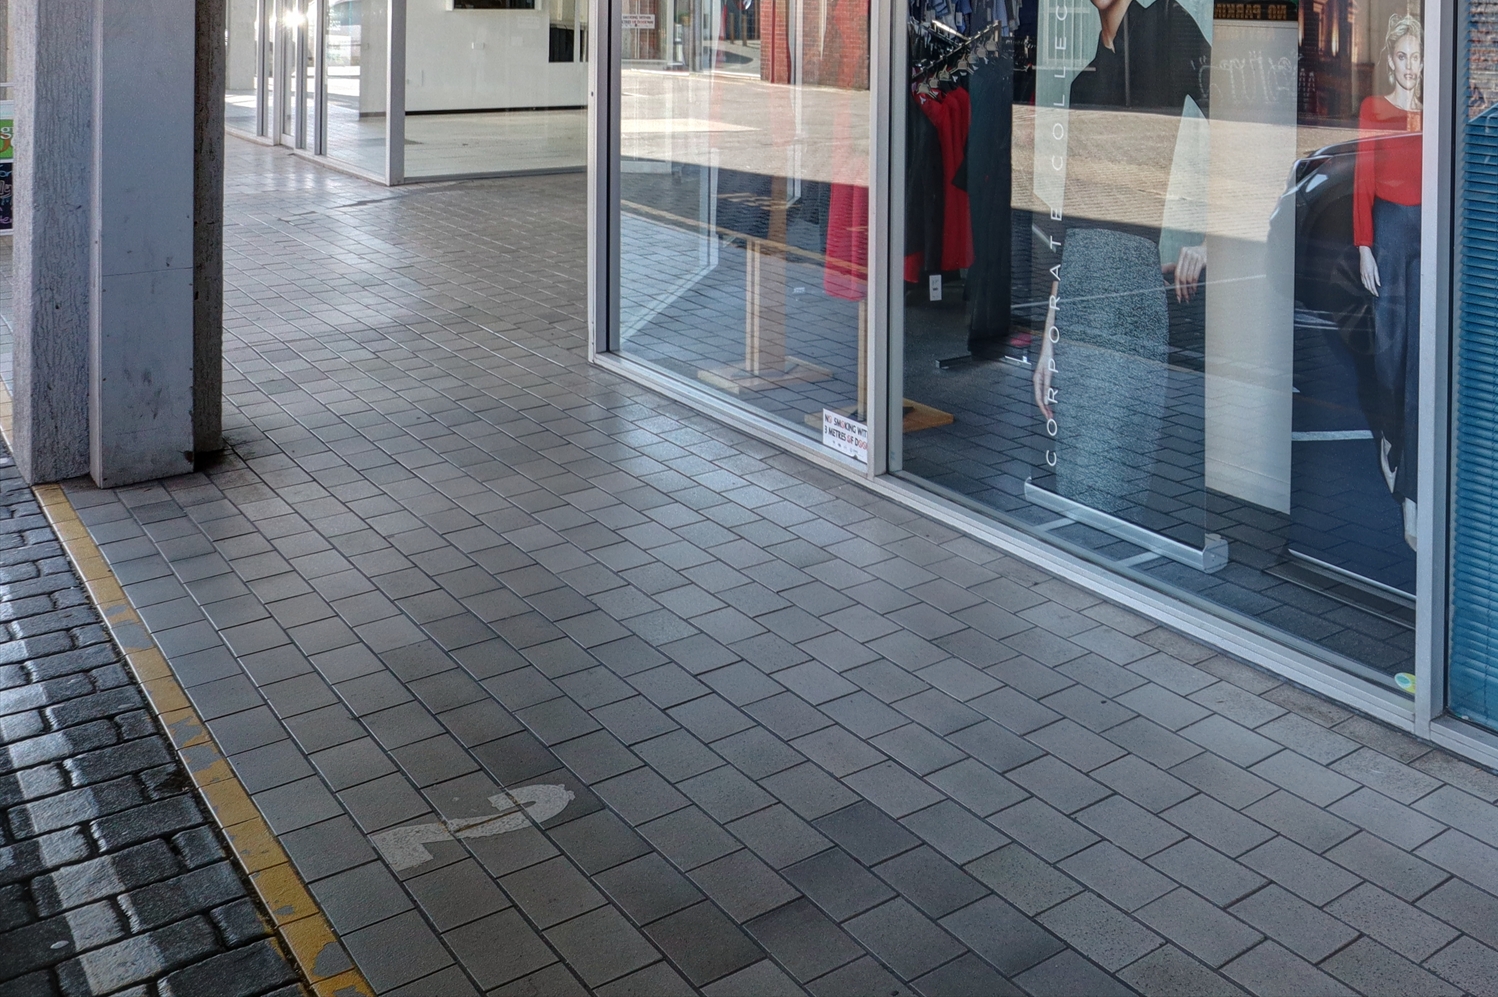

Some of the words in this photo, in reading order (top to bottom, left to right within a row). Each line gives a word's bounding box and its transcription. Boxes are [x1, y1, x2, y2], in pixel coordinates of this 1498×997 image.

[1046, 207, 1063, 467] CORPORATE
[828, 427, 846, 441] METRES
[834, 417, 857, 434] SMOKING
